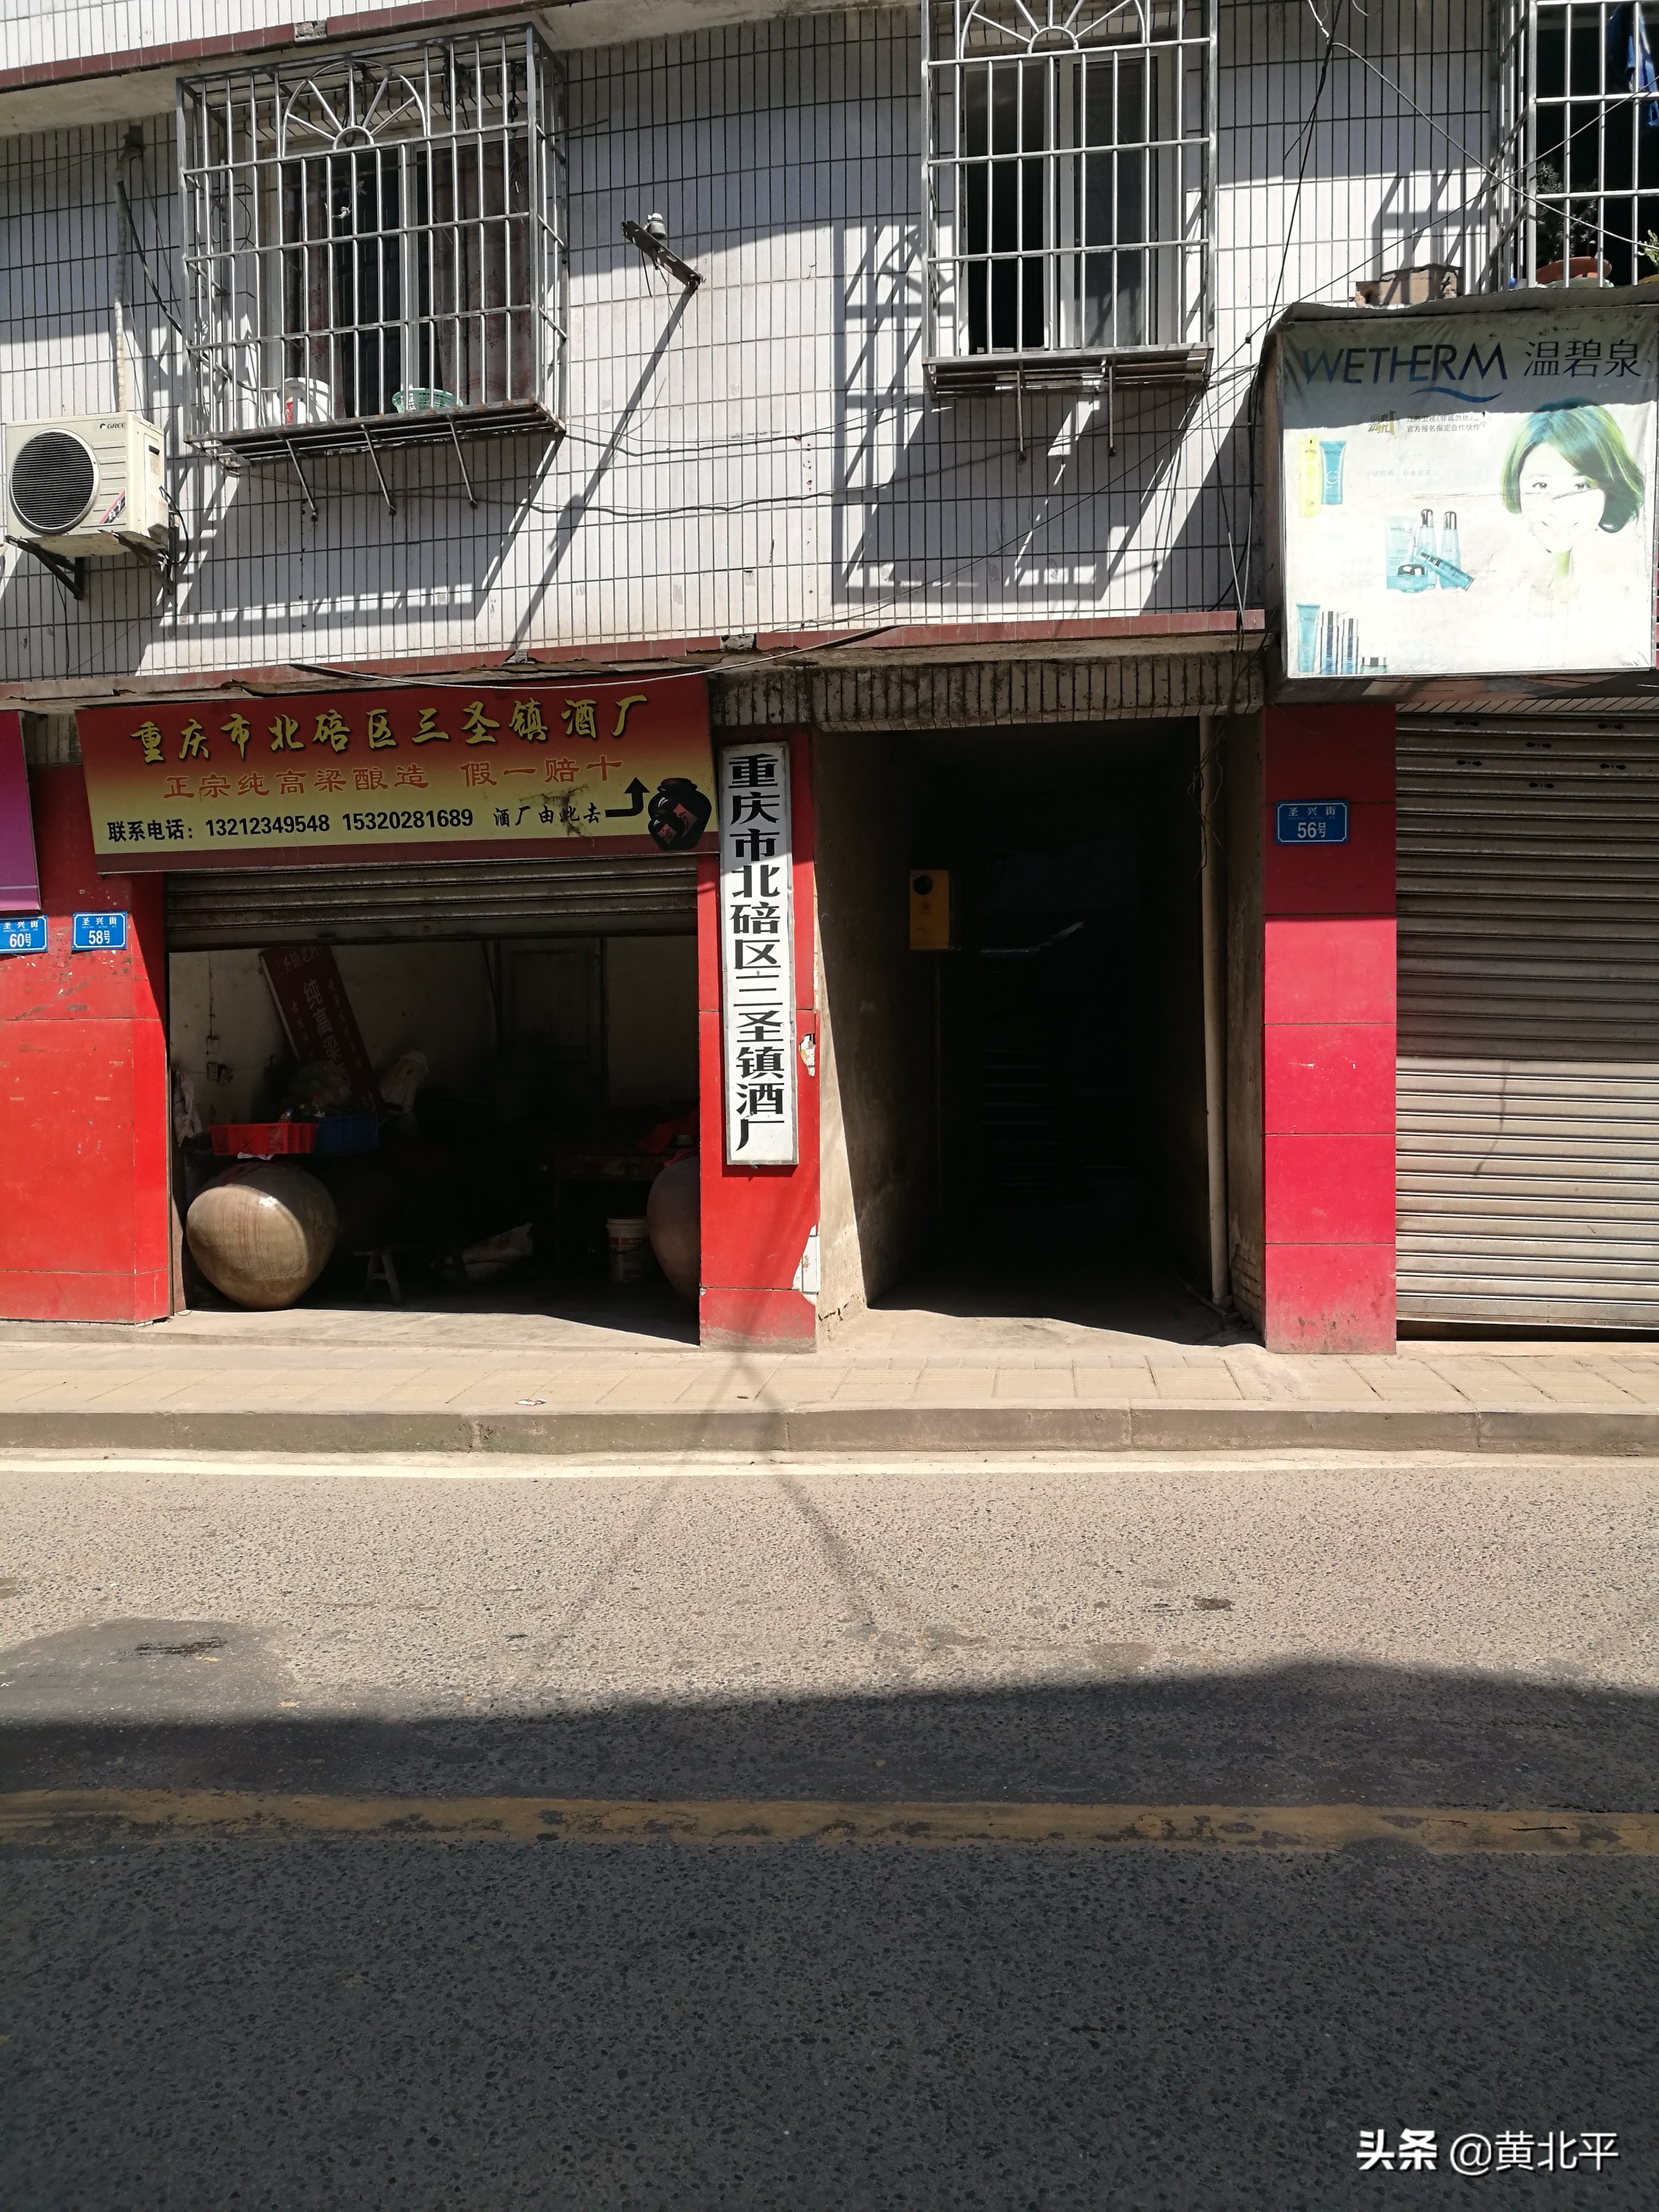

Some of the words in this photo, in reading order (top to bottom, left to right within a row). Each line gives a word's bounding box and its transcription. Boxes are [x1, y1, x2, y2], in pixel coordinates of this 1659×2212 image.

[1302, 341, 1508, 385] WETHERM
[1524, 338, 1642, 378] 温碧泉
[130, 695, 648, 763] 重庆市北碚区三圣镇酒厂
[163, 763, 429, 799] 正宗纯高梁酿造
[459, 755, 623, 788] 假一赔十
[206, 814, 330, 837] 13212349548
[342, 808, 473, 831] 15320281689
[493, 802, 601, 827] 酒厂由此去
[1288, 806, 1336, 817] 圣兴街
[1297, 822, 1326, 838] 56号
[3, 920, 39, 930] 圣兴街
[82, 916, 117, 926] 圣兴街
[9, 933, 32, 948] 60号
[89, 930, 110, 944] 58号
[728, 753, 785, 1152] 重庆市北碚区三圣镇酒厂
